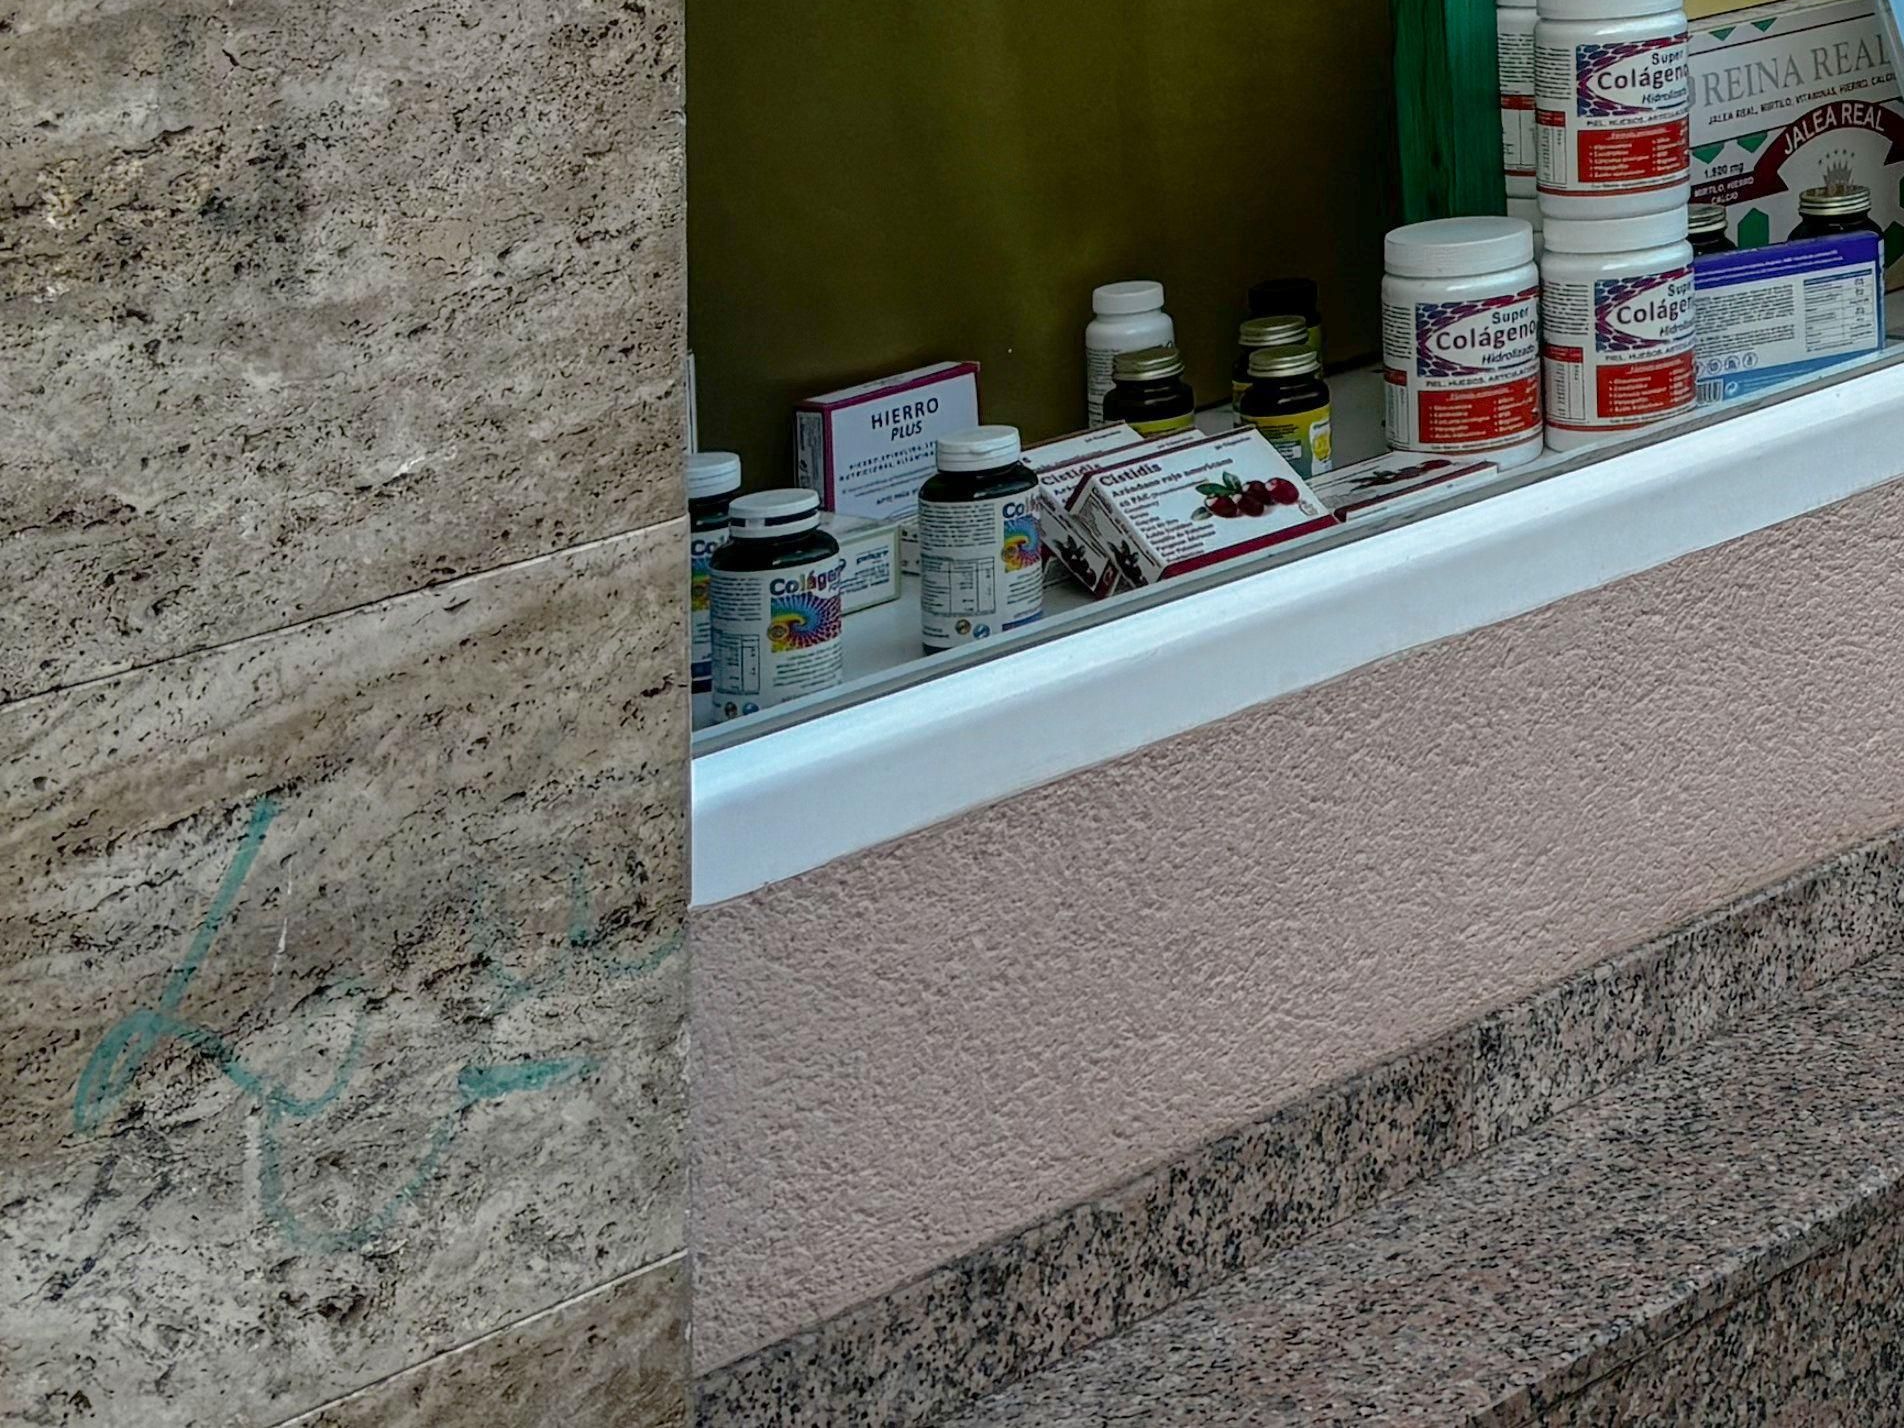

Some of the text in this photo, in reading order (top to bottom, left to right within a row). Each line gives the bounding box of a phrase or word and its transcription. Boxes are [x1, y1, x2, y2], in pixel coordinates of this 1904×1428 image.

[1651, 49, 1685, 67] Super
[1702, 54, 1806, 108] REINA
[1810, 33, 1893, 81] REAL
[1596, 60, 1690, 91] Colágeno
[1783, 105, 1837, 156] JALEA
[1840, 101, 1886, 133] REAL
[1491, 307, 1530, 327] Super
[1434, 320, 1538, 353] Colágeno
[871, 397, 940, 431] HIERRO
[889, 420, 923, 442] PLUS
[1099, 462, 1163, 488] Cistidis
